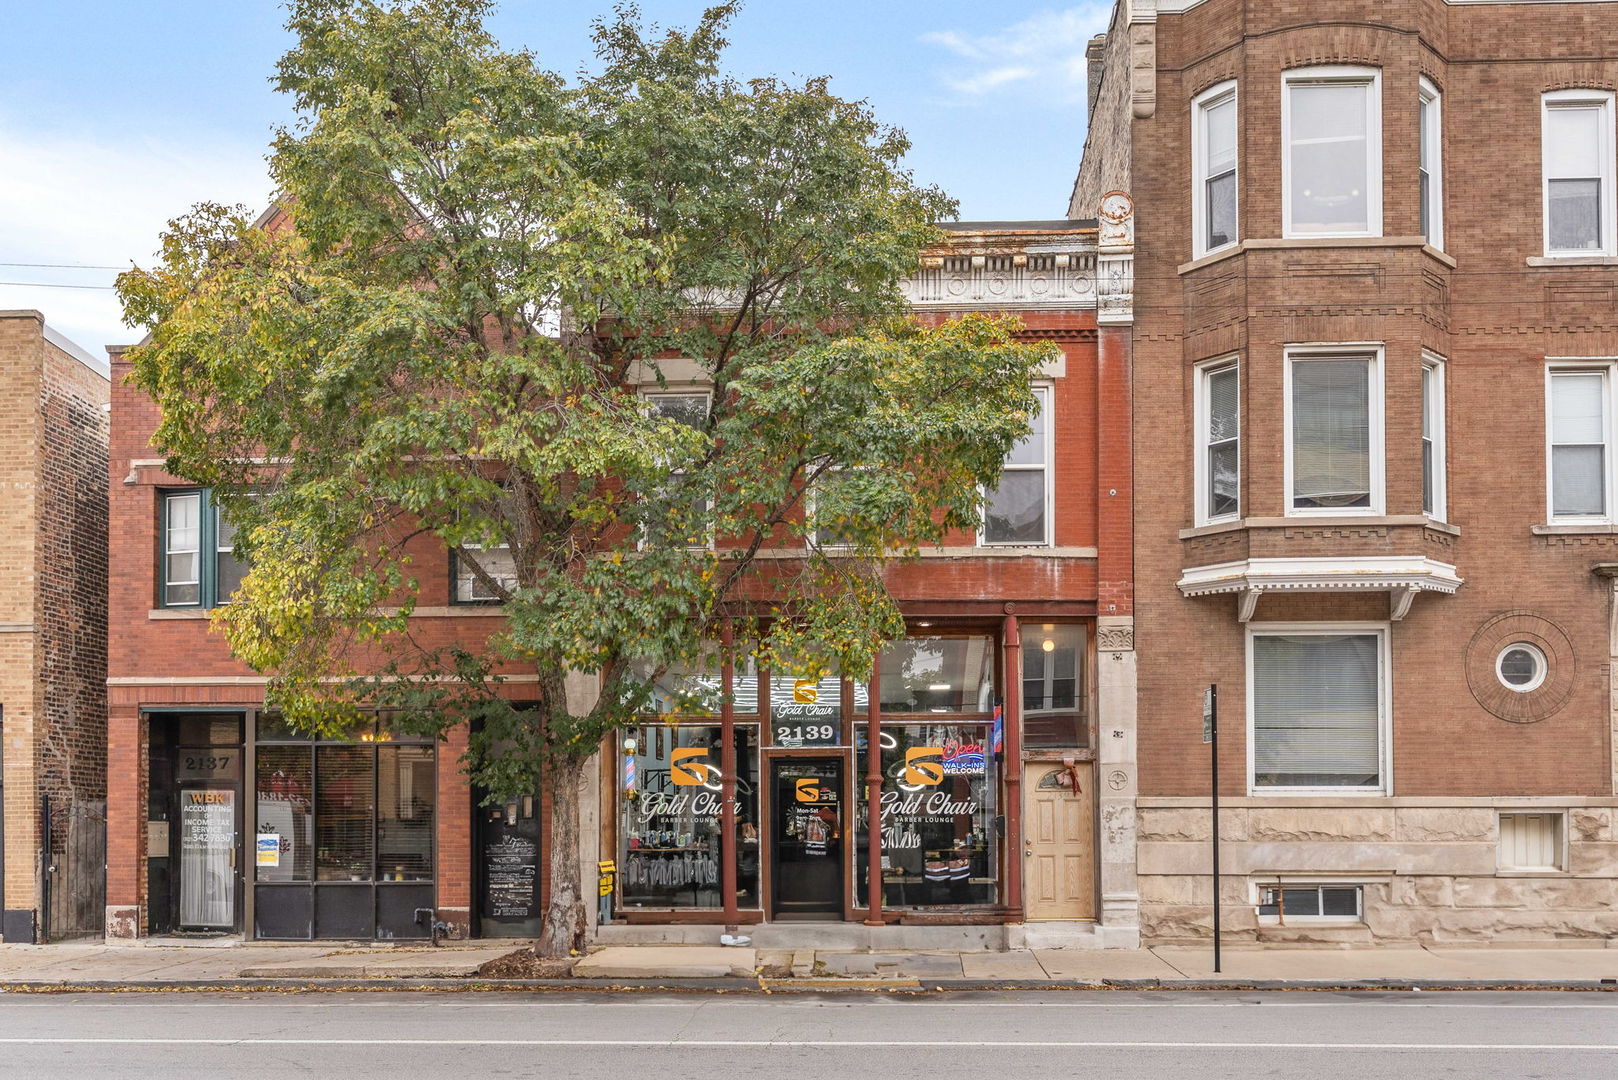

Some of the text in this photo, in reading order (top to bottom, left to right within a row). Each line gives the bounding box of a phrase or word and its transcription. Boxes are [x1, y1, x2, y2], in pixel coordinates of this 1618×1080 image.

[776, 702, 834, 718] Gold Chair
[777, 725, 833, 741] 2139
[943, 740, 984, 760] Open
[185, 757, 229, 769] 2137
[190, 792, 225, 804] WBK
[926, 791, 978, 815] Chair
[638, 792, 742, 823] Gold Char
